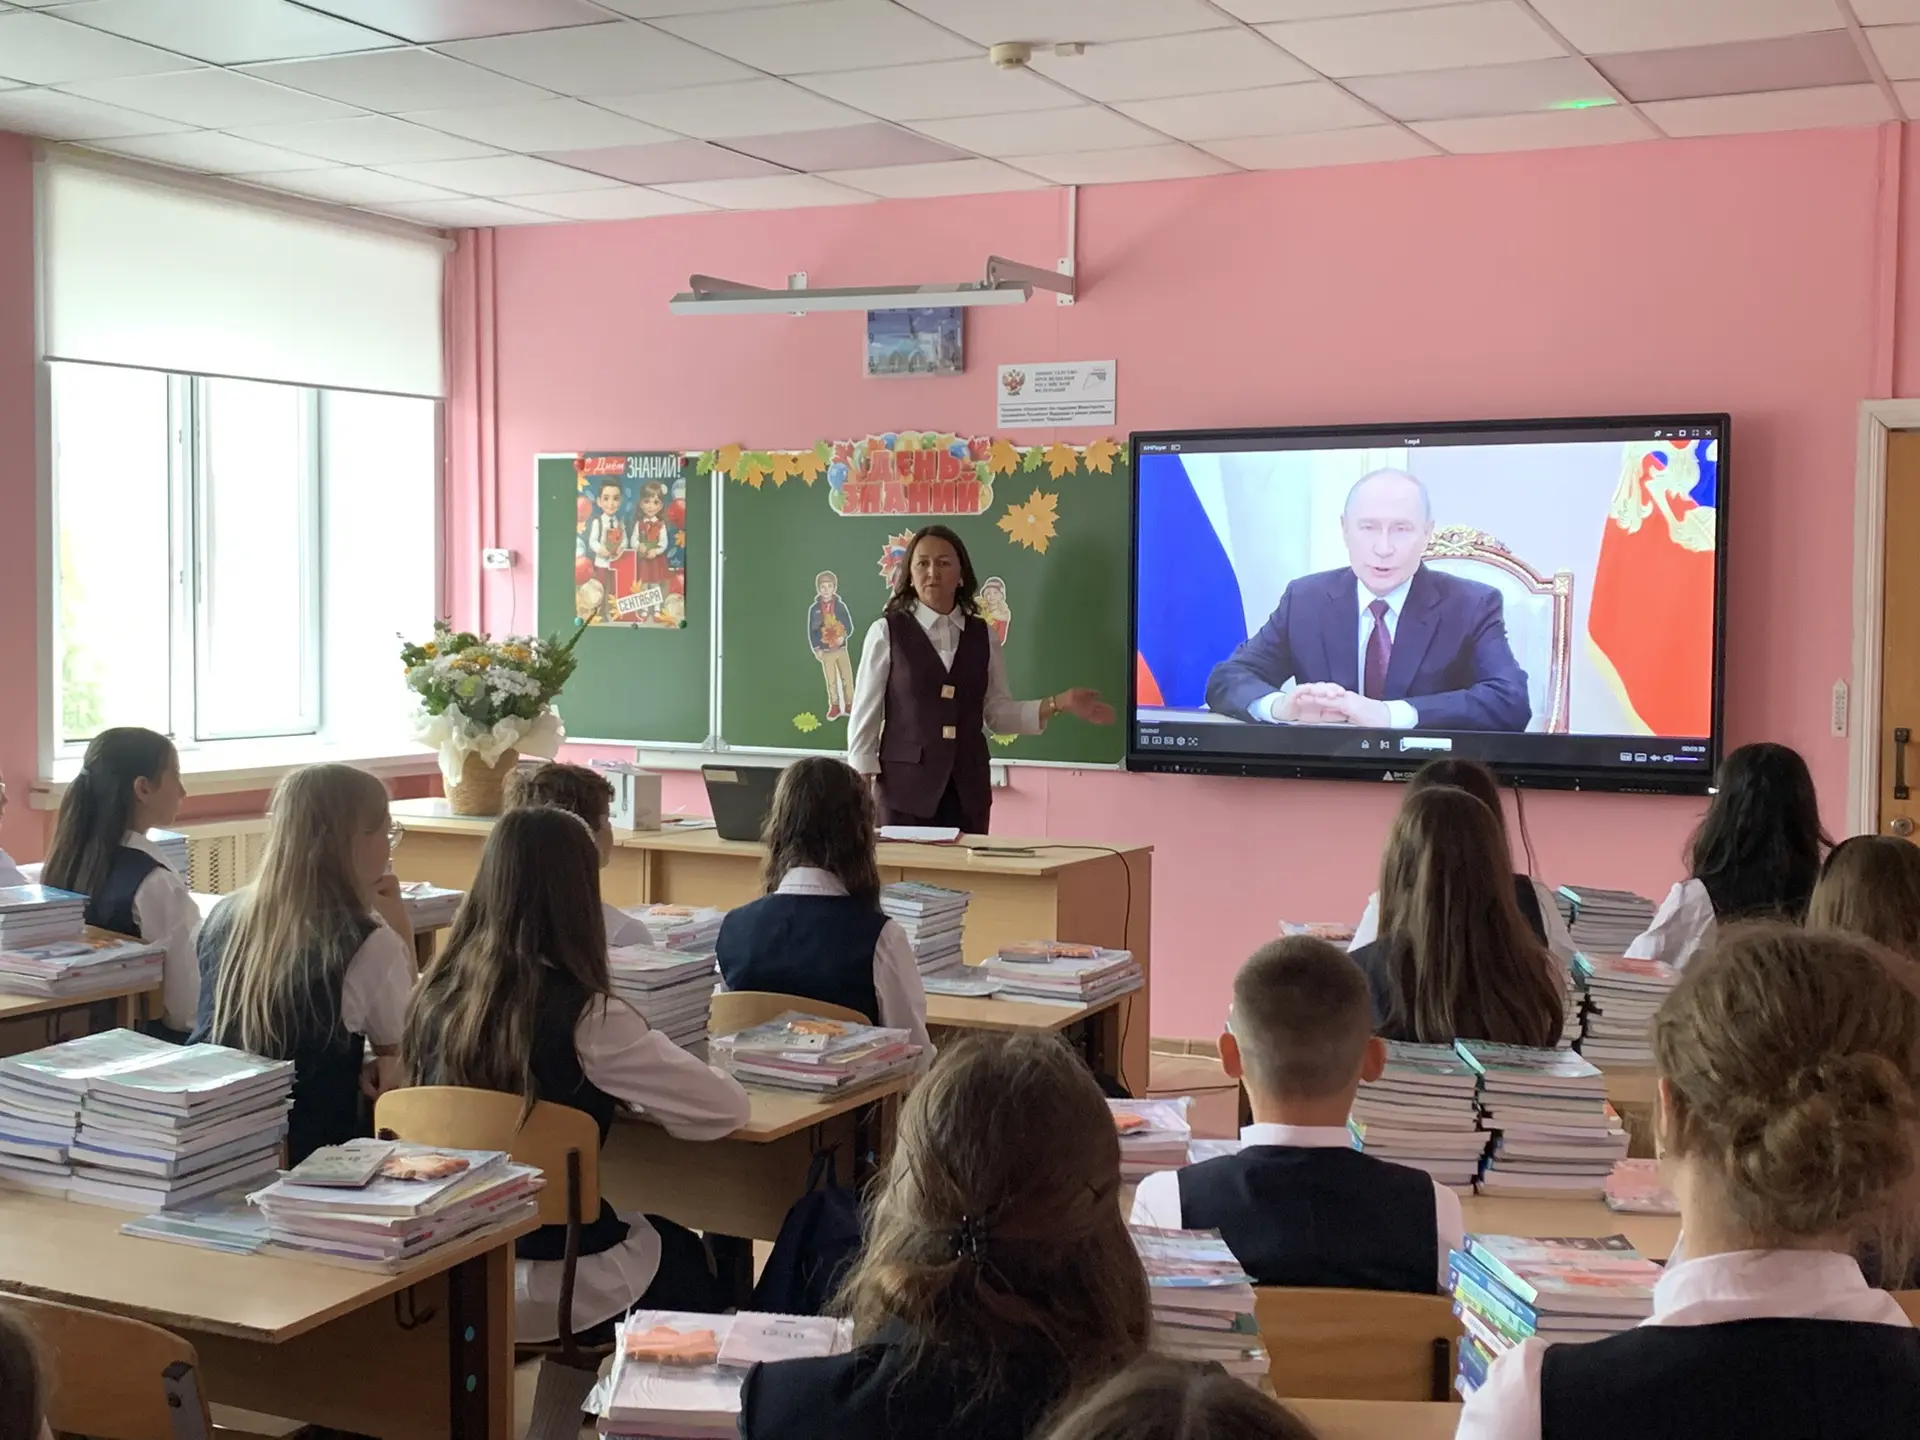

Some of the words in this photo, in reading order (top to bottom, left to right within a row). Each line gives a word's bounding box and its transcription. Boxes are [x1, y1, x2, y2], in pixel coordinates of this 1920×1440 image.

[626, 454, 682, 479] ЗНАНИЙ!
[867, 449, 962, 482] ДЕНЬ
[608, 549, 643, 623] 1
[618, 590, 661, 612] СЕНТЯБРЯ
